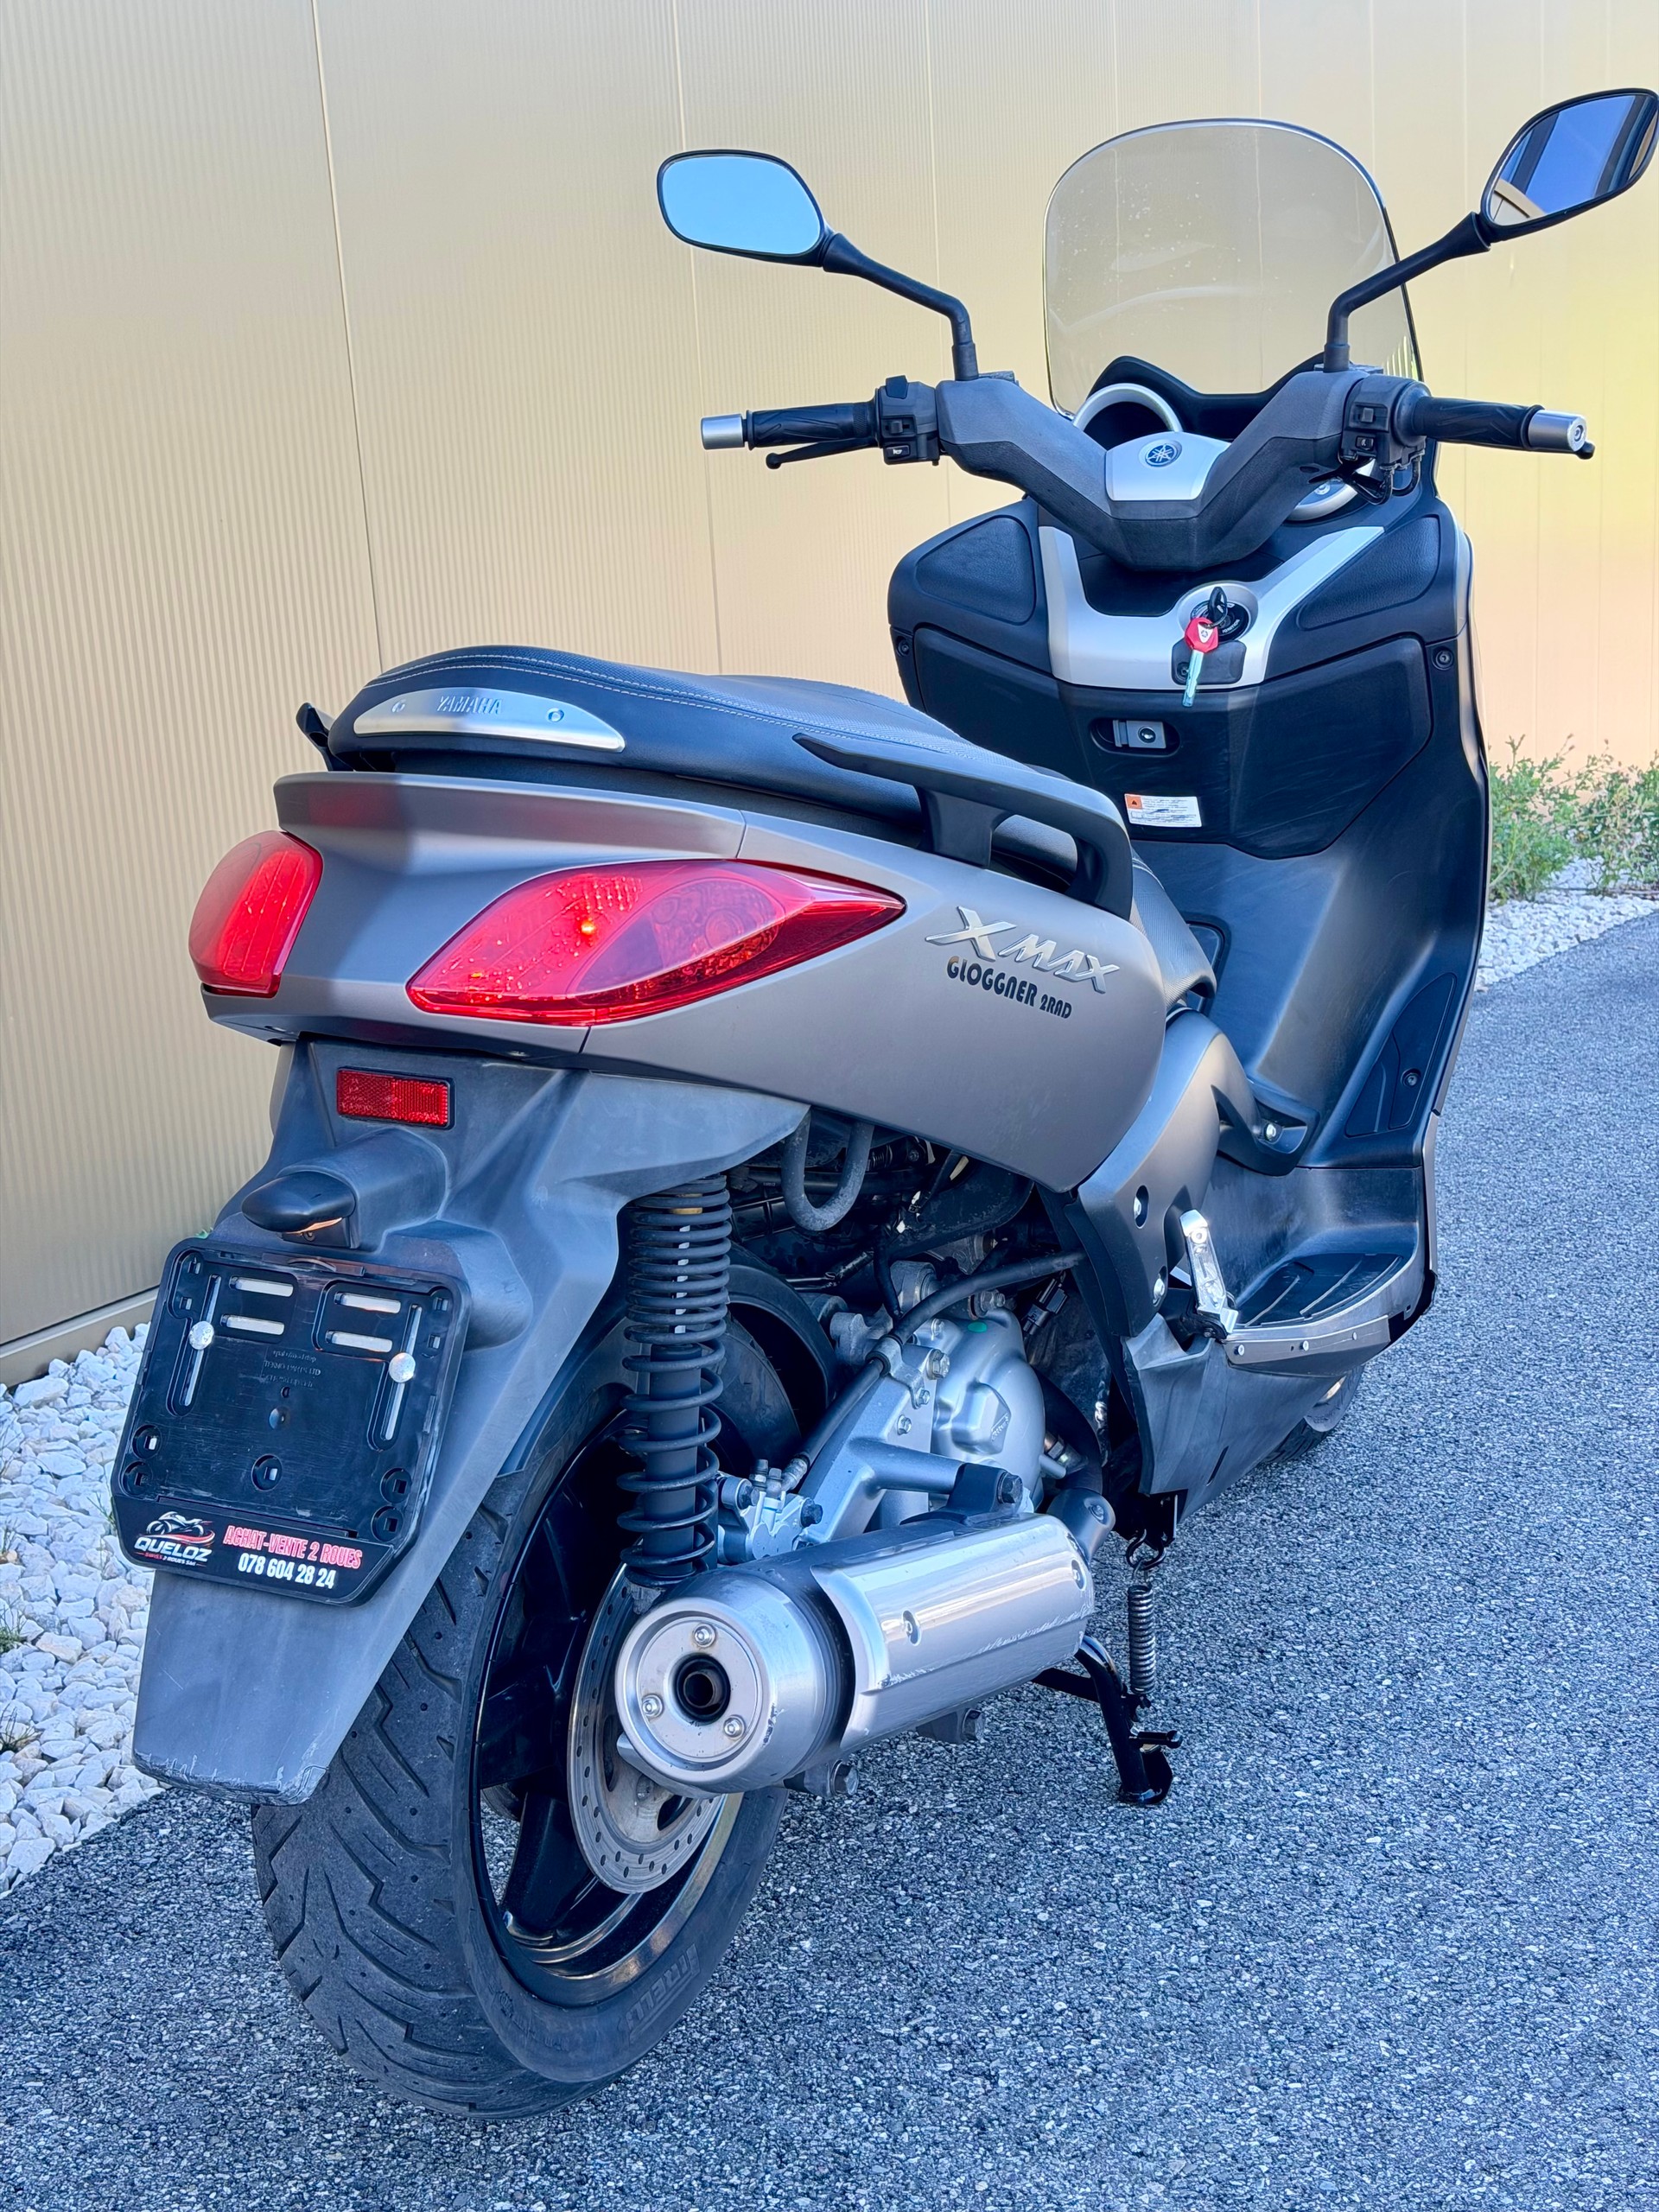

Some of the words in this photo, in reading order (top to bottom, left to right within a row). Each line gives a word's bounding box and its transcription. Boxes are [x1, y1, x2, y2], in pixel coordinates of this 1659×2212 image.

[436, 696, 502, 715] YAMAHA
[1039, 994, 1072, 1020] 2RAD
[134, 1536, 213, 1562] QUELOZ
[223, 1525, 308, 1559] ACHAT-VENTE
[307, 1541, 321, 1560] 2
[320, 1543, 363, 1569] ROUES
[238, 1553, 266, 1575] 078
[266, 1558, 296, 1580] 604
[295, 1563, 315, 1585] 28
[315, 1567, 337, 1589] 24
[626, 1942, 701, 2032] PIRELLI
